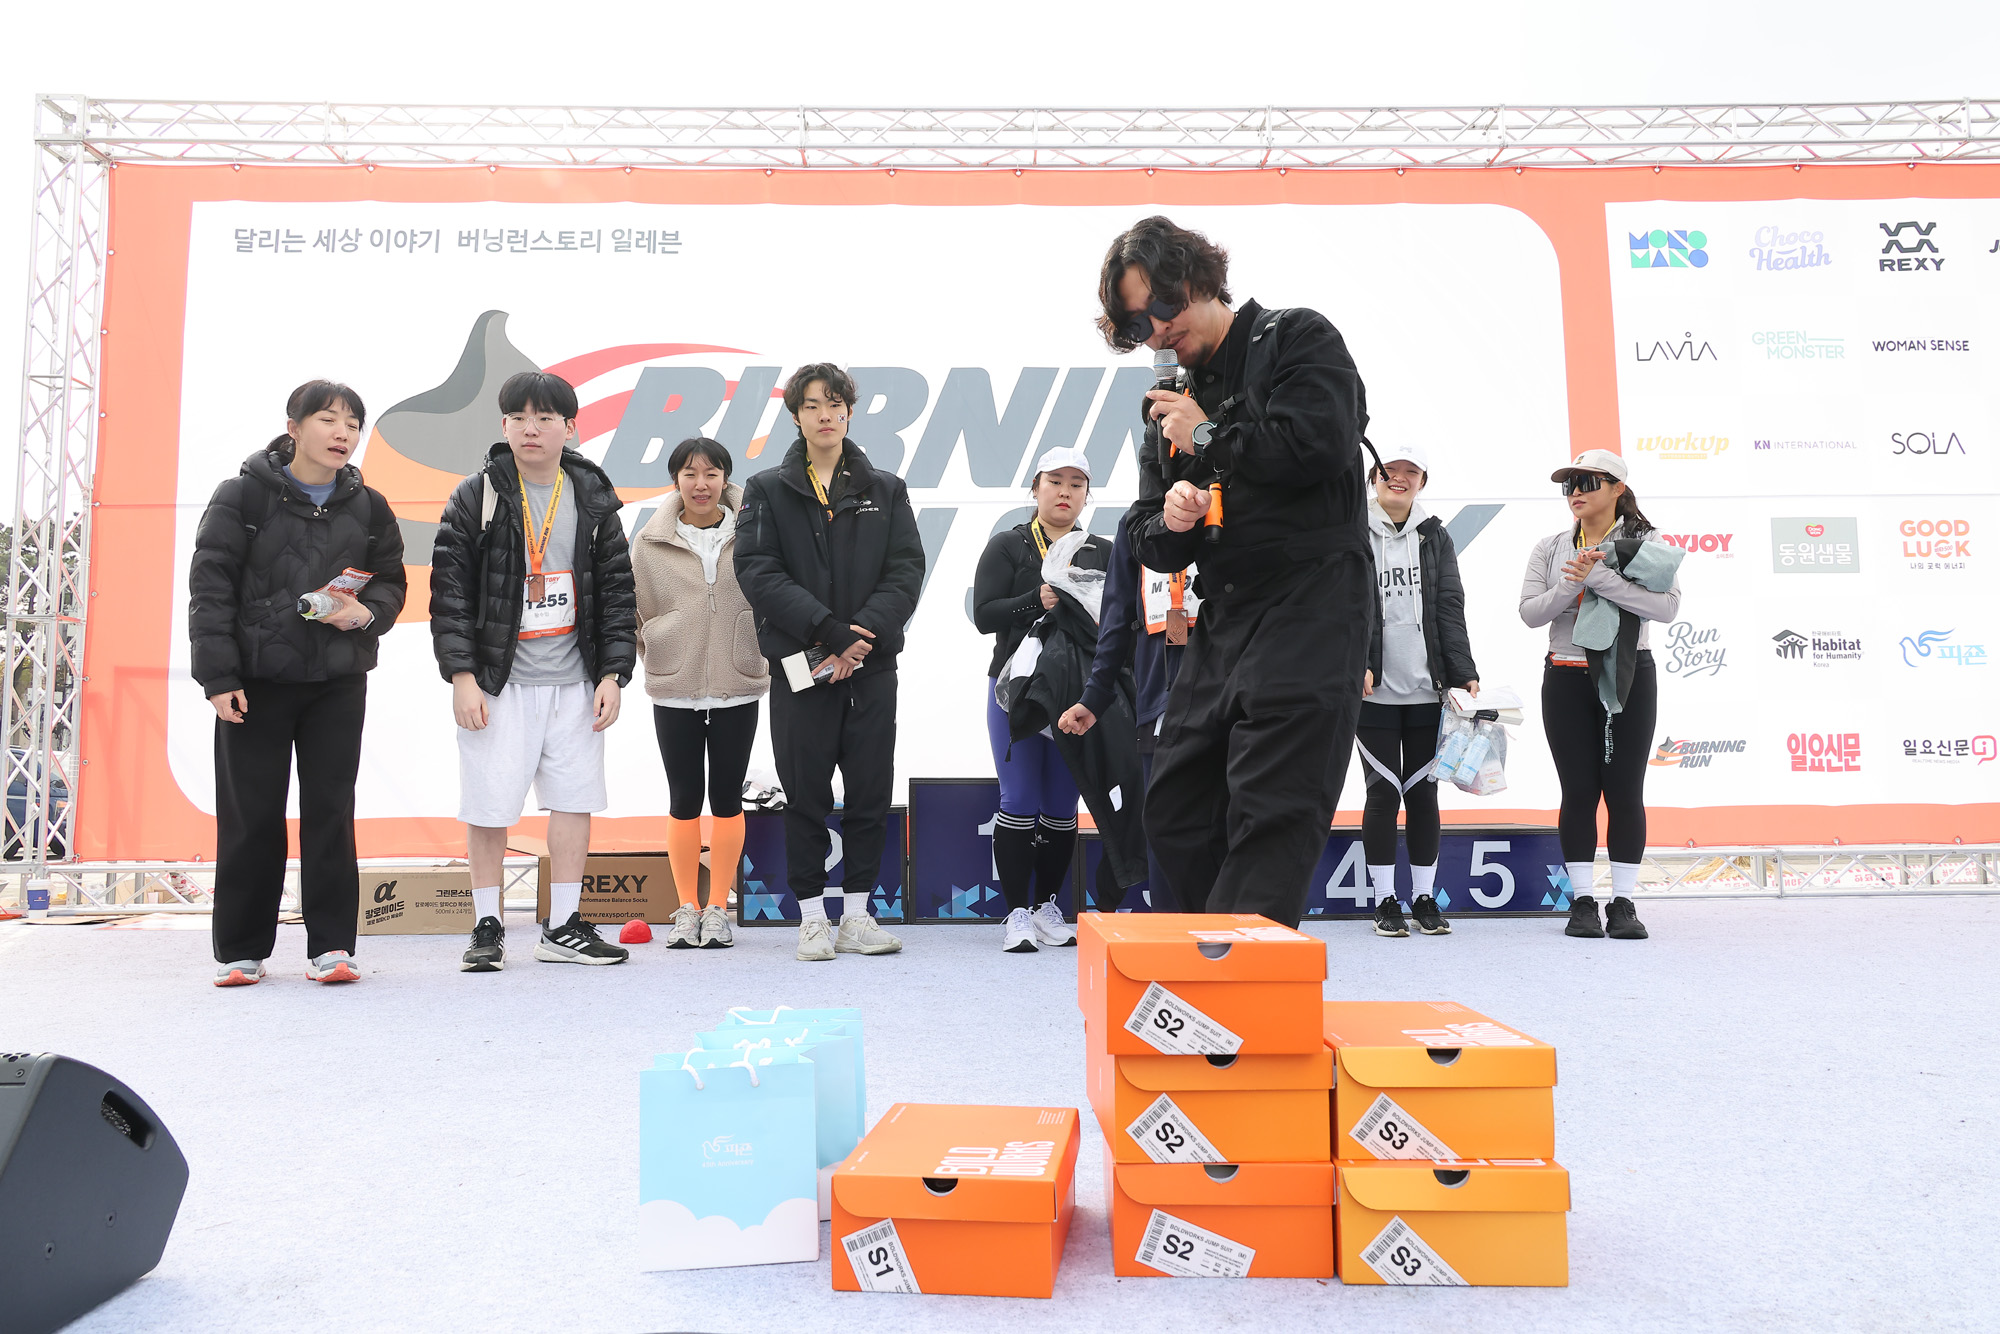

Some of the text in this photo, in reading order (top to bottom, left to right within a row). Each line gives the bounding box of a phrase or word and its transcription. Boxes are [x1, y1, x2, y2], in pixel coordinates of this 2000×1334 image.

[234, 228, 441, 254] 달리는 세상 이야기
[458, 228, 683, 255] 버닝런스토리 일레븐
[1628, 229, 1707, 250] MONO
[1754, 225, 1824, 248] Choco
[1630, 248, 1709, 269] MANO
[1748, 243, 1832, 271] Health
[1879, 257, 1945, 272] REXY
[1751, 330, 1807, 345] GREEN
[1872, 339, 1970, 351] WOMAN SENSE
[1767, 345, 1845, 360] MONSTER
[1754, 439, 1858, 450] KN INTERNATIONAL
[1899, 519, 1970, 537] GOOD
[538, 536, 546, 553] BURNING
[1661, 533, 1734, 553] OYJOY
[1778, 542, 1853, 567] 동원샘물
[1902, 539, 1972, 559] LUCK
[1378, 566, 1420, 588] ORE
[1665, 621, 1720, 649] Run
[1812, 638, 1861, 651] Habitat
[1665, 646, 1727, 677] Story
[1812, 652, 1862, 661] for Humanity
[1937, 644, 1988, 666] 피죤
[1679, 739, 1747, 755] BURNING
[1786, 732, 1861, 773] 일요신문
[1902, 739, 1970, 757] 일요신문
[1678, 754, 1713, 769] RUN
[580, 874, 648, 894] REXY
[1326, 840, 1374, 908] 4
[1468, 840, 1516, 909] 5
[365, 900, 405, 920] 칼로에이드
[581, 911, 645, 919] www.rexysport.com
[1153, 1008, 1185, 1038] S2
[1164, 998, 1196, 1022] BOLDWORKS
[1195, 1020, 1210, 1031] JUMP
[1210, 1029, 1222, 1039] SUIT
[1225, 1039, 1234, 1047] (M)
[1155, 1122, 1185, 1154] S2
[1170, 1113, 1197, 1143] BOLDWORKS
[1195, 1141, 1209, 1155] JUMP
[1378, 1120, 1409, 1150] S3
[1392, 1111, 1421, 1138] BOLDWORKS
[1420, 1136, 1434, 1149] JUMP
[1432, 1146, 1445, 1157] SUIT
[1162, 1233, 1195, 1261] S2
[1169, 1223, 1247, 1260] BOLDWORKS JUMP SUIT (M)
[867, 1246, 894, 1278] S1
[888, 1241, 907, 1278] BOLDWORKS
[1390, 1245, 1422, 1277] S3
[1404, 1236, 1435, 1266] BOLDWORKS
[1433, 1264, 1448, 1278] JUMP
